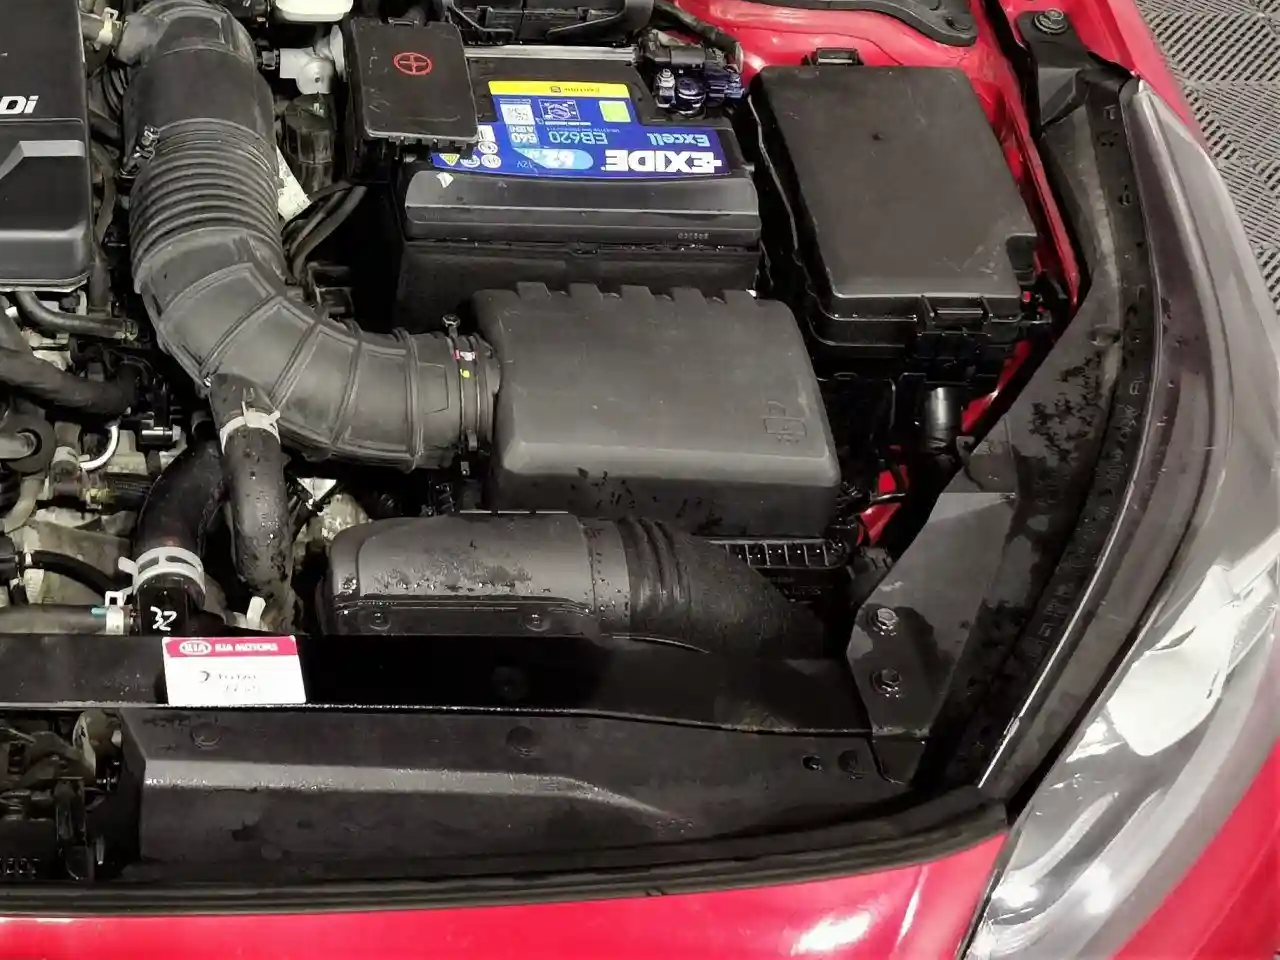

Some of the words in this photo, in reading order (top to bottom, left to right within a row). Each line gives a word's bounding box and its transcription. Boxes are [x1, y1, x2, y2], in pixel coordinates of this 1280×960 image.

[548, 131, 609, 145] EB620
[647, 132, 710, 147] Excell
[604, 149, 722, 174] EXIDE
